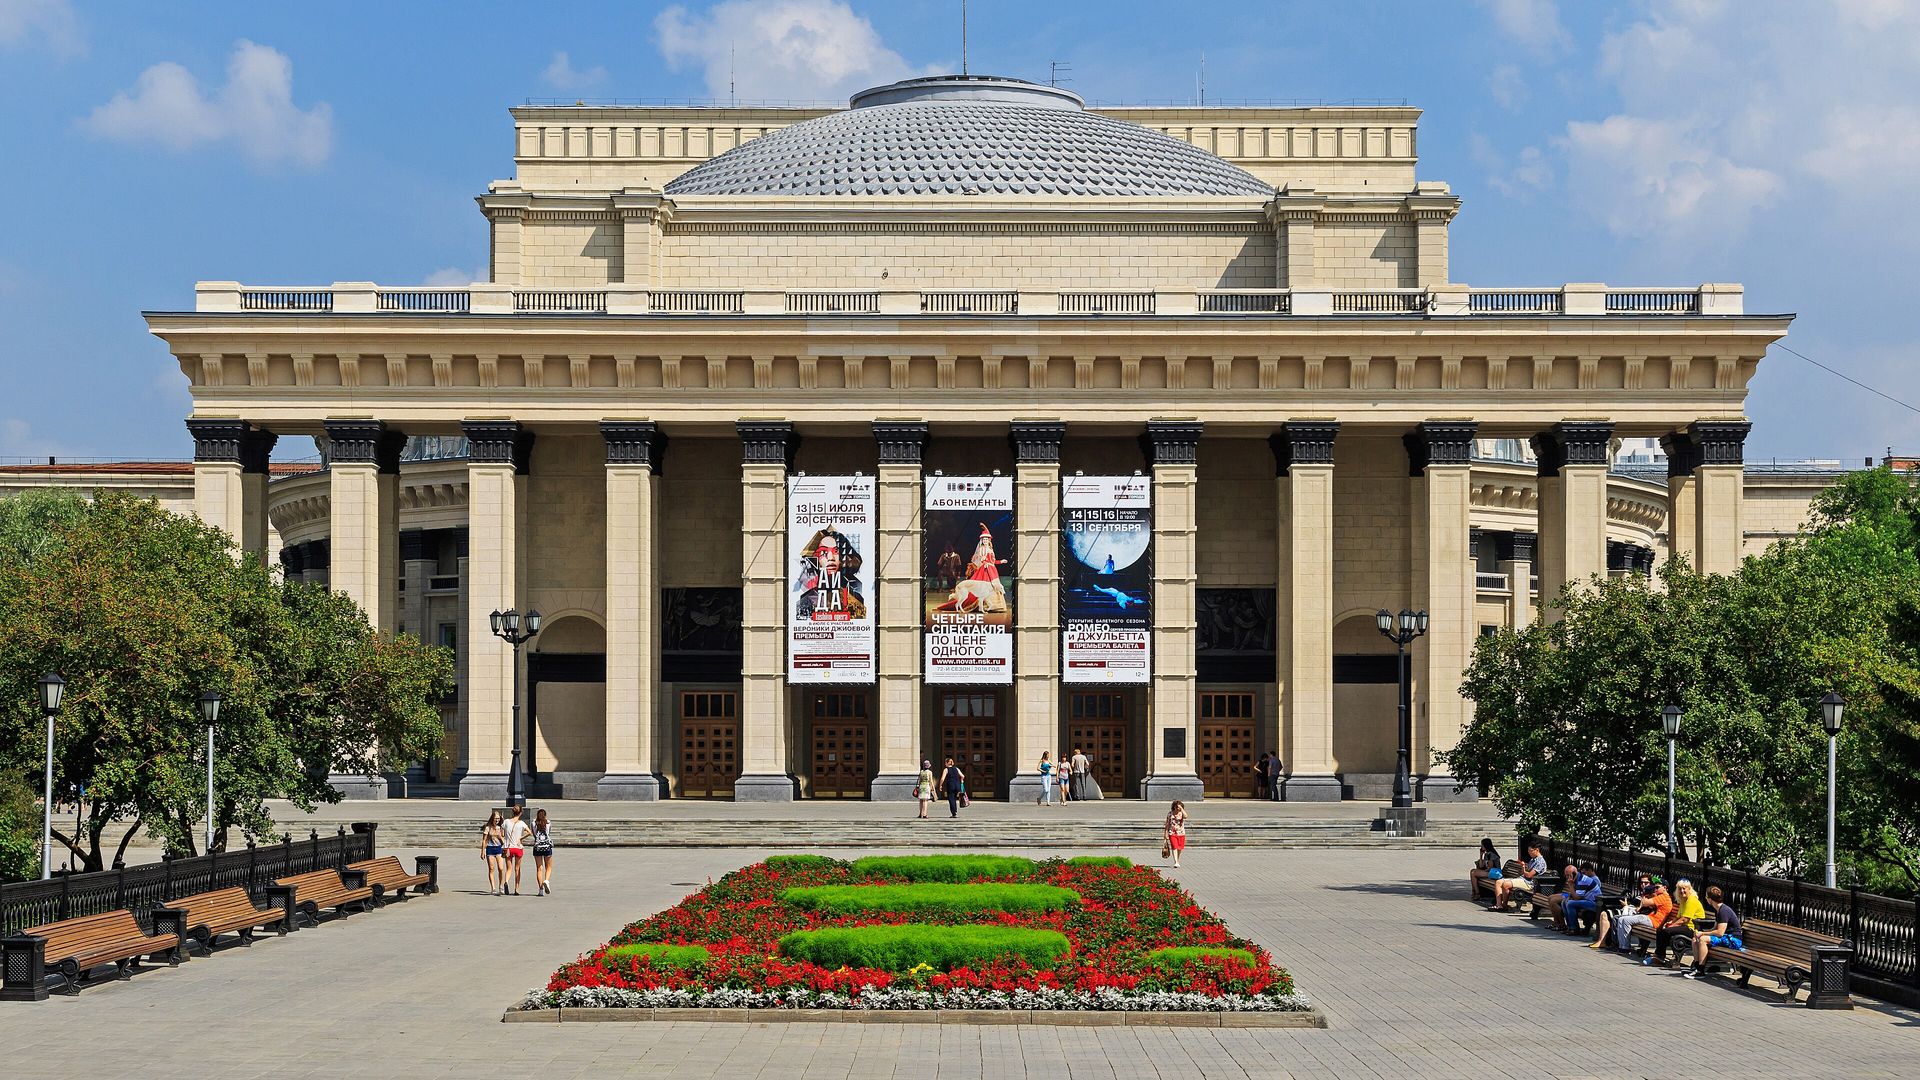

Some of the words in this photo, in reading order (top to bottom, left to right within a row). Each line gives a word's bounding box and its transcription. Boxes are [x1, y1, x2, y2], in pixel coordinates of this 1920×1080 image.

[796, 504, 808, 512] 13
[812, 504, 824, 512] 15
[829, 504, 864, 512] ИЮЛЯ
[1071, 511, 1082, 519] 14
[1087, 511, 1099, 519] 15
[1103, 511, 1115, 519] 16
[796, 516, 809, 524] 20
[812, 516, 866, 524] СЕНТЯБРЯ
[1071, 523, 1082, 532] 13
[932, 614, 984, 624] ЧЕТЫРЕ
[932, 624, 1005, 634] СПЕКТАКЛЯ
[1068, 624, 1110, 632] РОМЕО
[932, 636, 949, 644] ПО
[954, 636, 986, 646] ЦЕНЕ
[1078, 633, 1144, 641] ДЖУЛЬЕТТА
